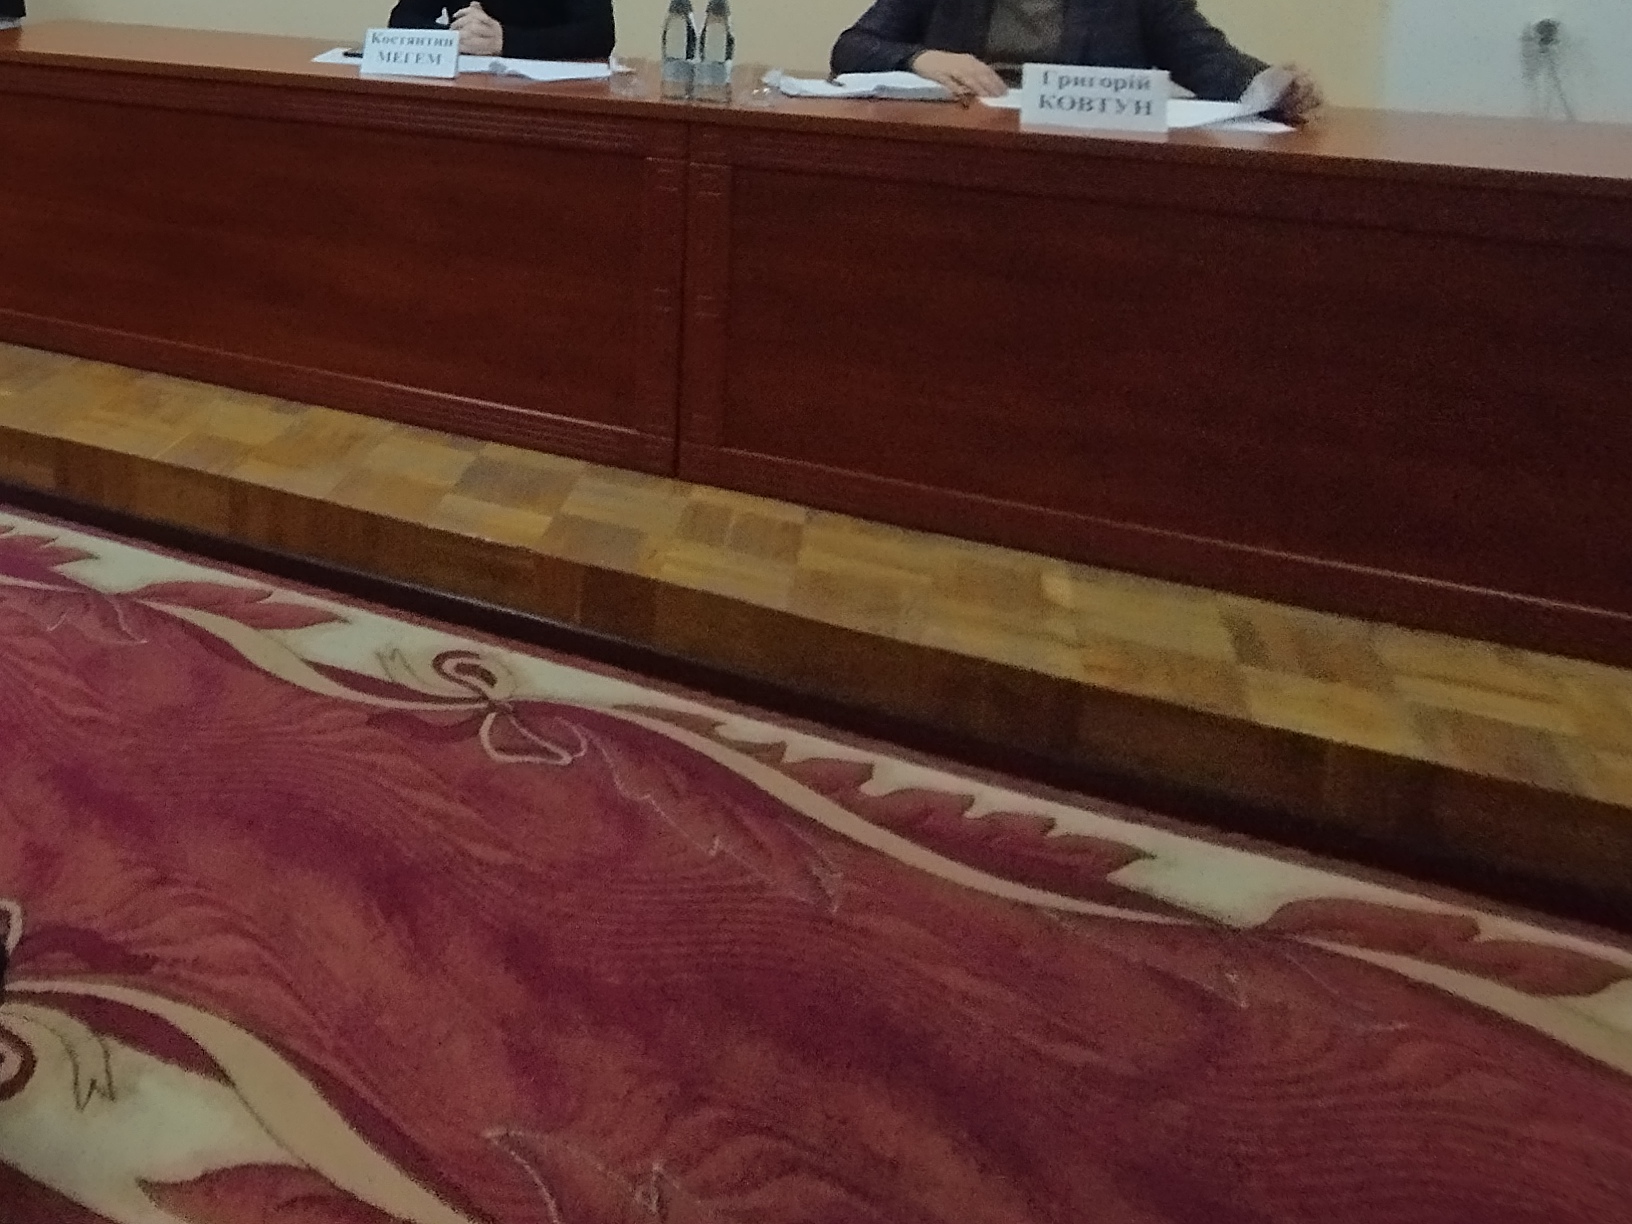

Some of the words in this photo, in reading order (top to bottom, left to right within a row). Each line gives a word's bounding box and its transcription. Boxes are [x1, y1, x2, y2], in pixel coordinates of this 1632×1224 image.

[371, 32, 454, 47] Костянтин
[378, 51, 442, 66] МЕГЕМ
[1041, 70, 1151, 92] Григорій
[1038, 94, 1153, 116] КОВТУН
